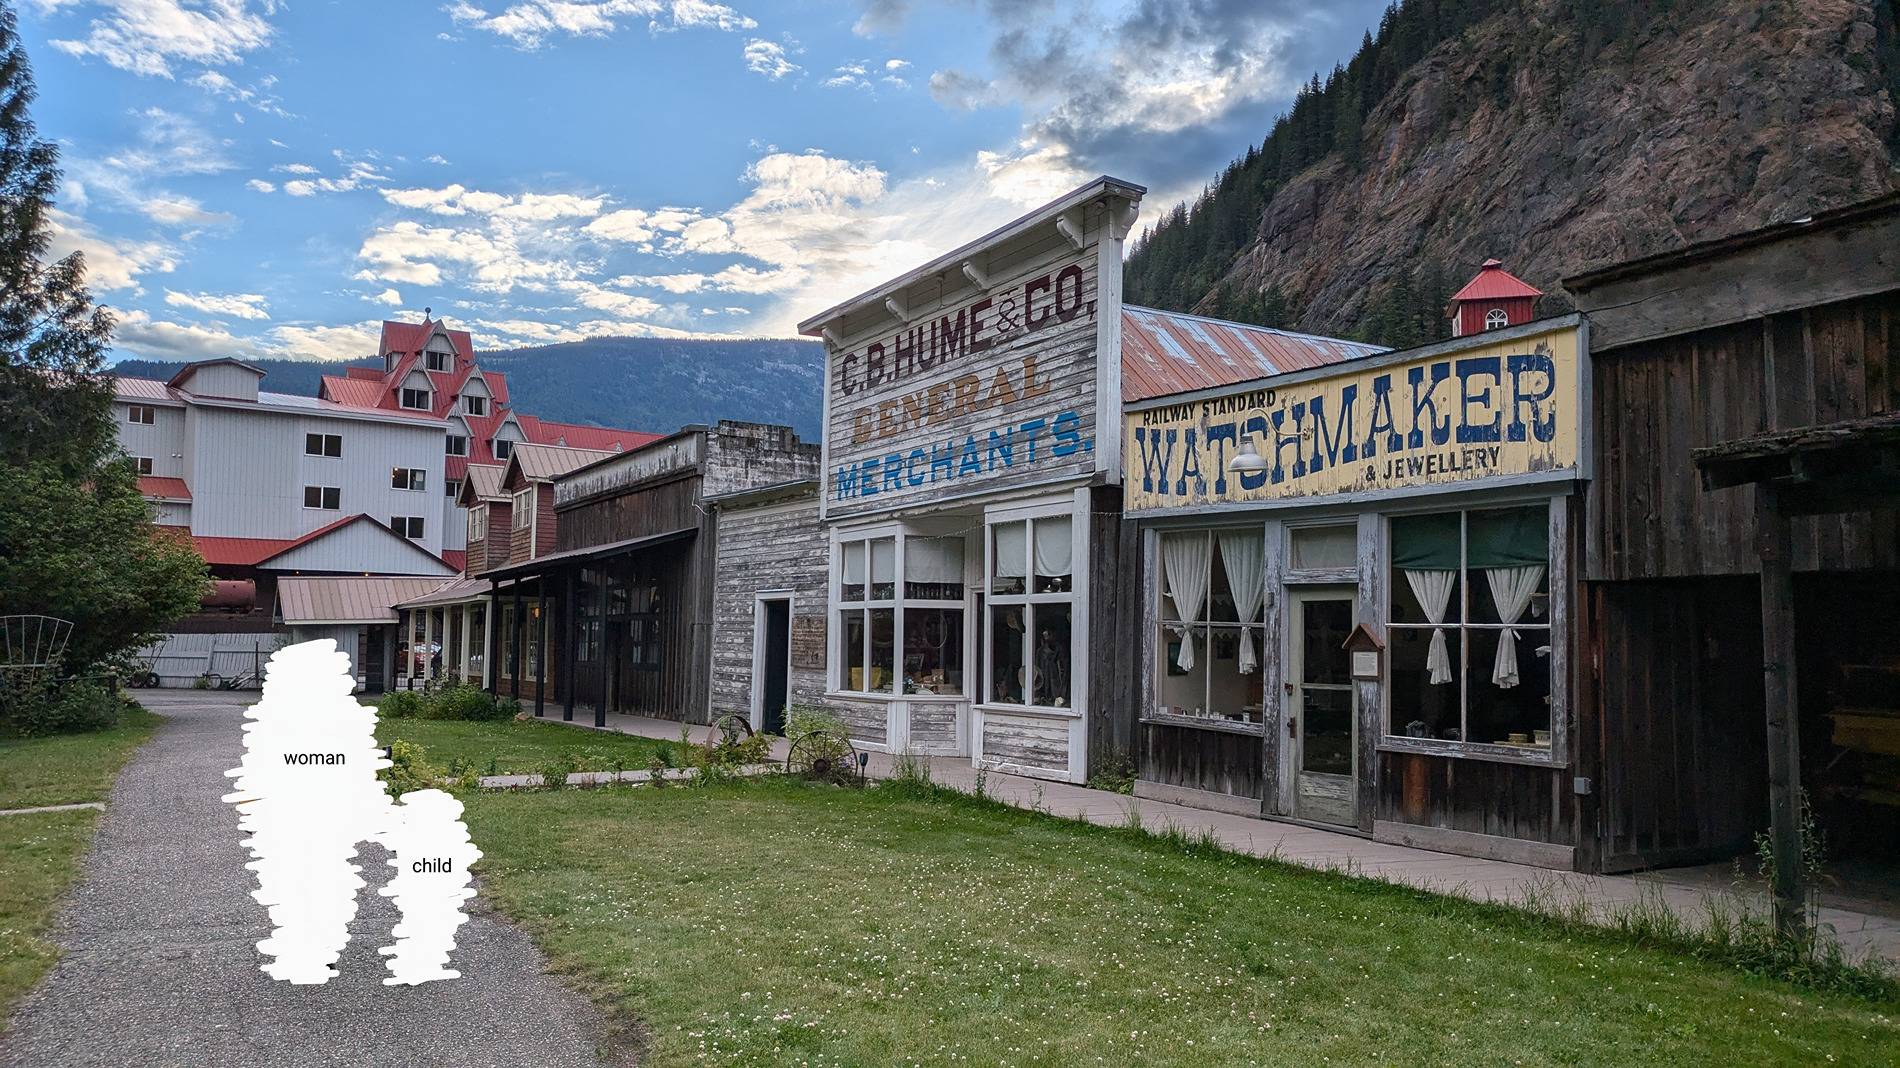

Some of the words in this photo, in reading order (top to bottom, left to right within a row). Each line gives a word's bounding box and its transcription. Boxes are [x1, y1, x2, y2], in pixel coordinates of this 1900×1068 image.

[996, 287, 1019, 333] &
[853, 355, 1051, 444] GENERAL
[1143, 403, 1195, 426] RAILWAY
[1202, 390, 1276, 417] STANDARD
[1135, 354, 1556, 496] WATCHMAKER
[1365, 465, 1376, 482] &
[1383, 446, 1500, 480] JEWELLERY
